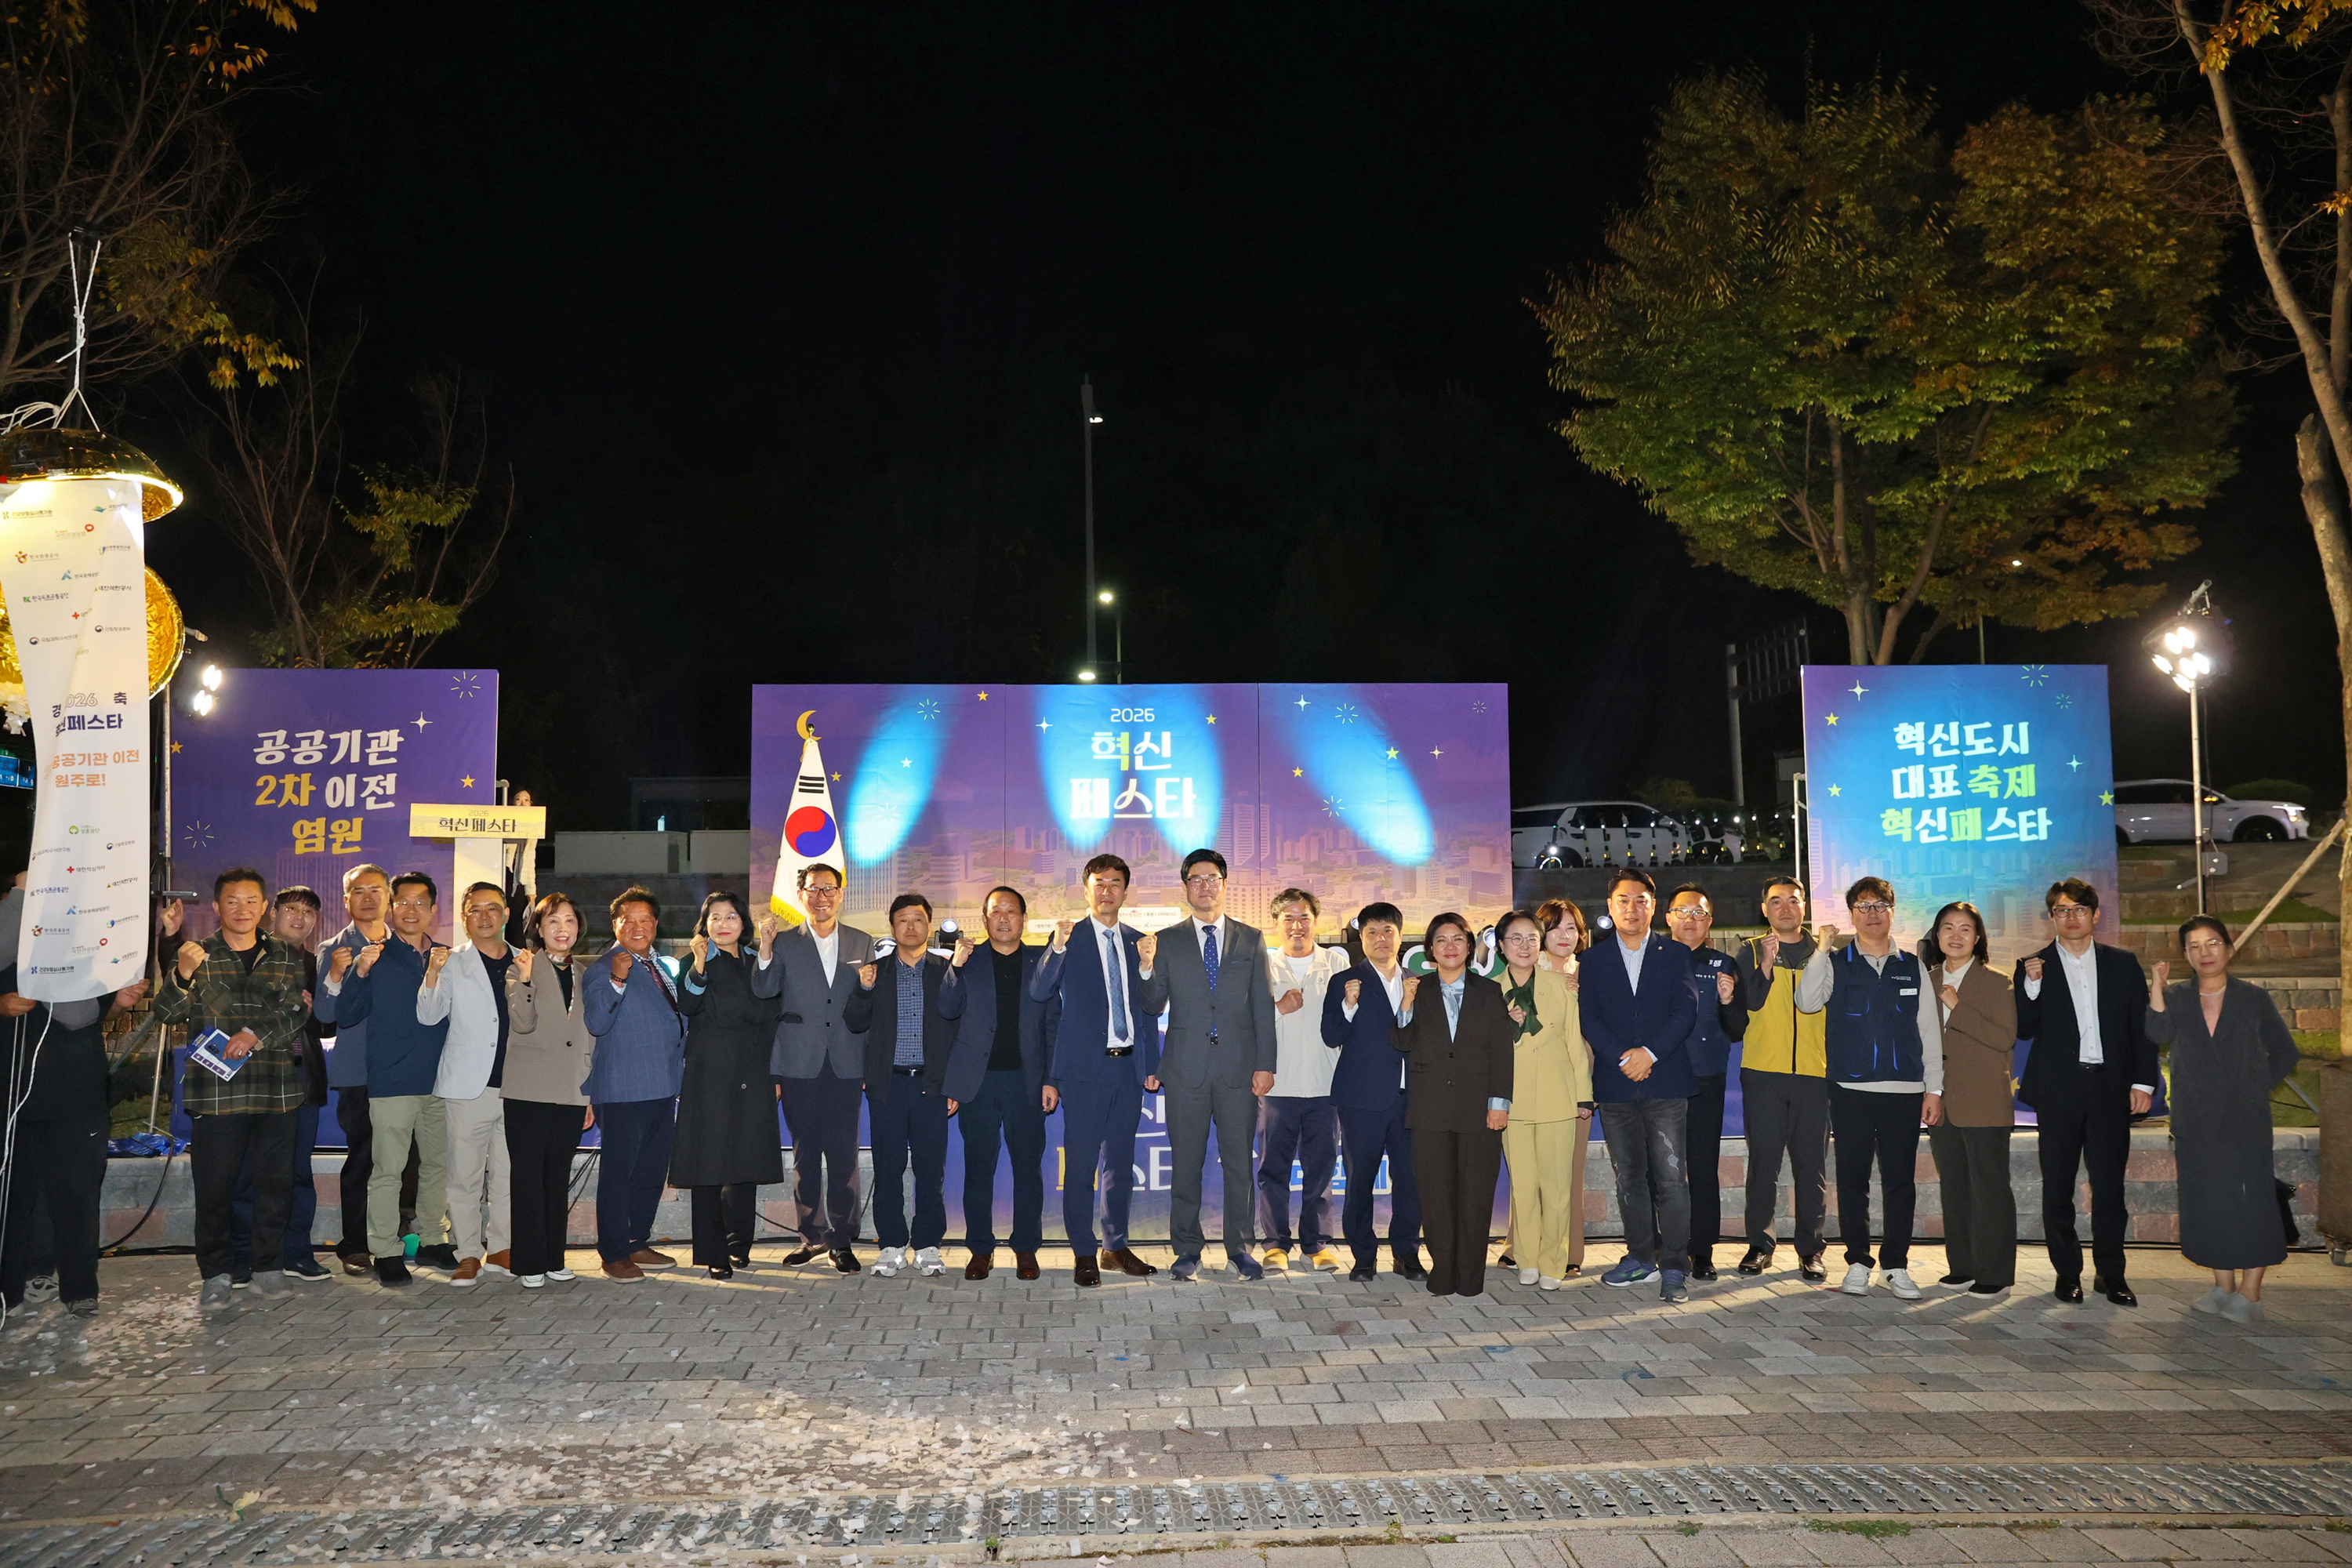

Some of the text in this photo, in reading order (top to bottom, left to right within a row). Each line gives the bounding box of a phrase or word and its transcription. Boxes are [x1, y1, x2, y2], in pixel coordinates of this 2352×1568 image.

[52, 704, 62, 718] 경
[64, 692, 98, 710] 026
[114, 691, 128, 705] 축
[1110, 708, 1156, 723] 2026
[113, 750, 140, 764] 이전
[252, 728, 405, 766] 공공기관
[1091, 731, 1172, 771] 혁신
[1893, 720, 2031, 758] 혁신도시
[55, 773, 106, 788] 원주로!
[255, 772, 397, 810] 2차 이전
[1069, 777, 1197, 818] 페스타
[1891, 764, 2036, 800] 대표 축제
[292, 816, 364, 855] 염원
[1880, 806, 2053, 844] 혁신페스타
[72, 946, 100, 954] 국민건강보험
